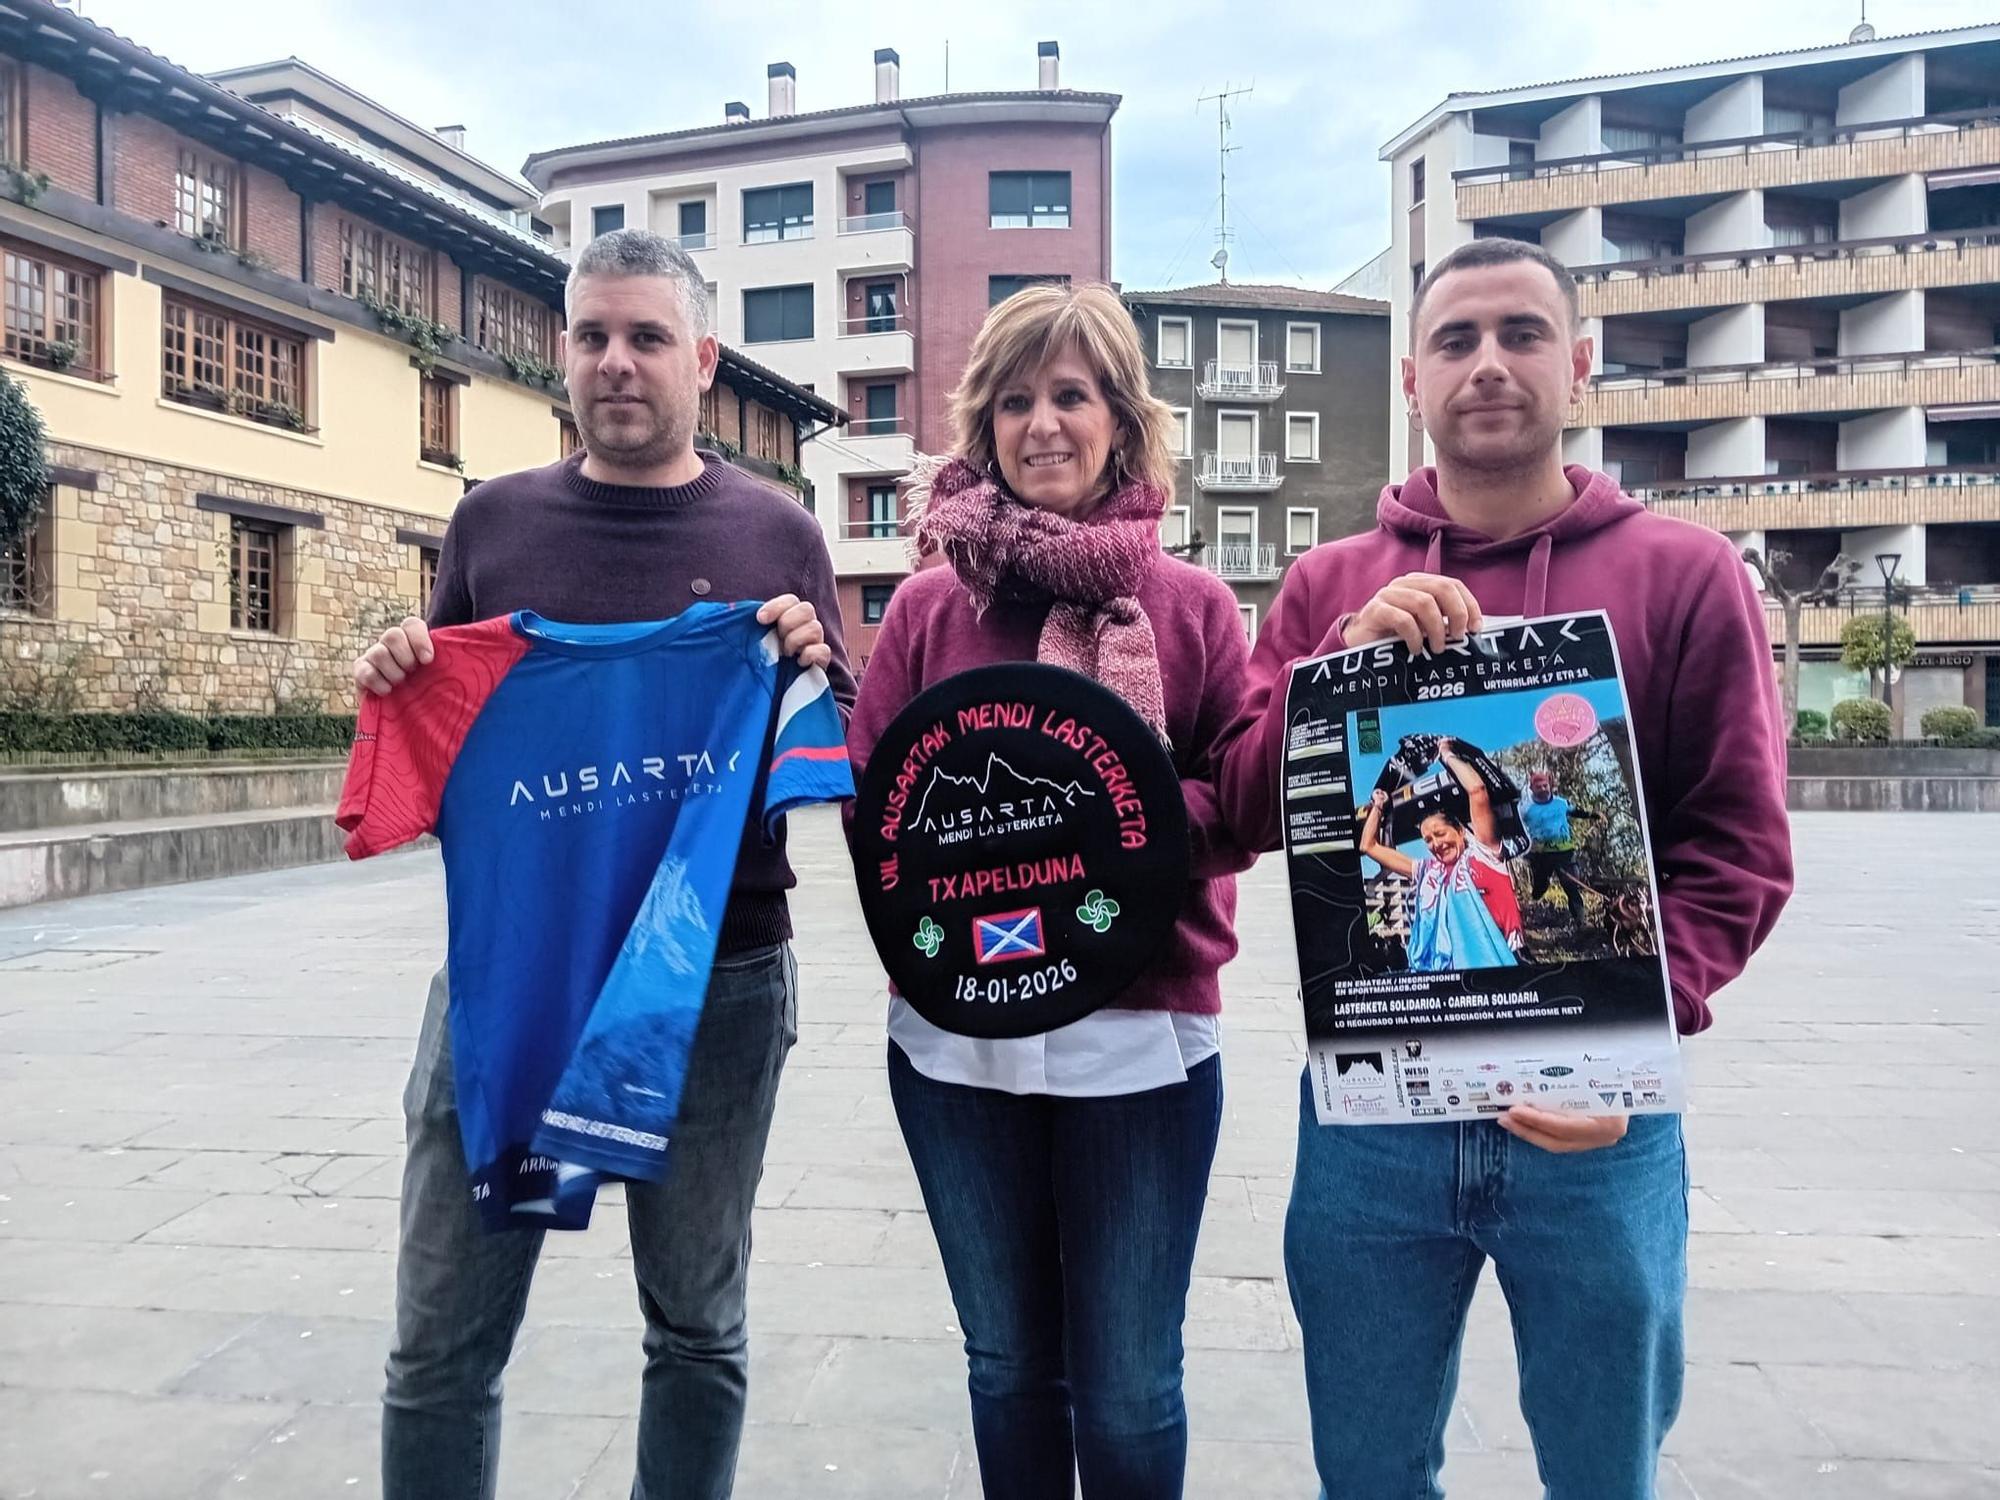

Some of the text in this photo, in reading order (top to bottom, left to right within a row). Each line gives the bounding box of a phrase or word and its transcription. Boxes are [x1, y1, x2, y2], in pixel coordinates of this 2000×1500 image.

[1333, 653, 1565, 695] MENDI LASTERKETA
[1542, 673, 1554, 684] 17
[1556, 669, 1575, 681] ETA
[1417, 681, 1466, 700] 2026
[510, 750, 741, 806] AUSARTAK
[880, 720, 951, 841] AUSARTAK
[957, 703, 1035, 735] MENDI
[1041, 710, 1148, 849] LASTERKETA
[540, 800, 603, 821] MENDI
[924, 791, 1076, 833] AUSARTAK
[938, 813, 1063, 845] MENDI LASTERKETA
[928, 853, 1086, 903] TXAPELDUNA
[955, 958, 1077, 1003] 18-01-2026
[1335, 981, 1353, 989] IZEN
[1355, 978, 1392, 987] EMATEAK
[1399, 973, 1461, 984] INSCRIPCIONES
[1335, 983, 1431, 996] EN SPORTMANIACS.COM
[1334, 1000, 1388, 1015] LASTERKETA
[1390, 997, 1442, 1012] SOLIDARIOA
[1448, 994, 1490, 1008] CARRERA
[1491, 991, 1540, 1005] SOLIDARIA
[1335, 1021, 1345, 1029] LO
[1347, 1018, 1394, 1028] RECAUDADO
[1410, 1016, 1431, 1024] PARA
[1432, 1015, 1443, 1023] LA
[1496, 1010, 1514, 1019] ANE
[1561, 1006, 1584, 1015] RETT
